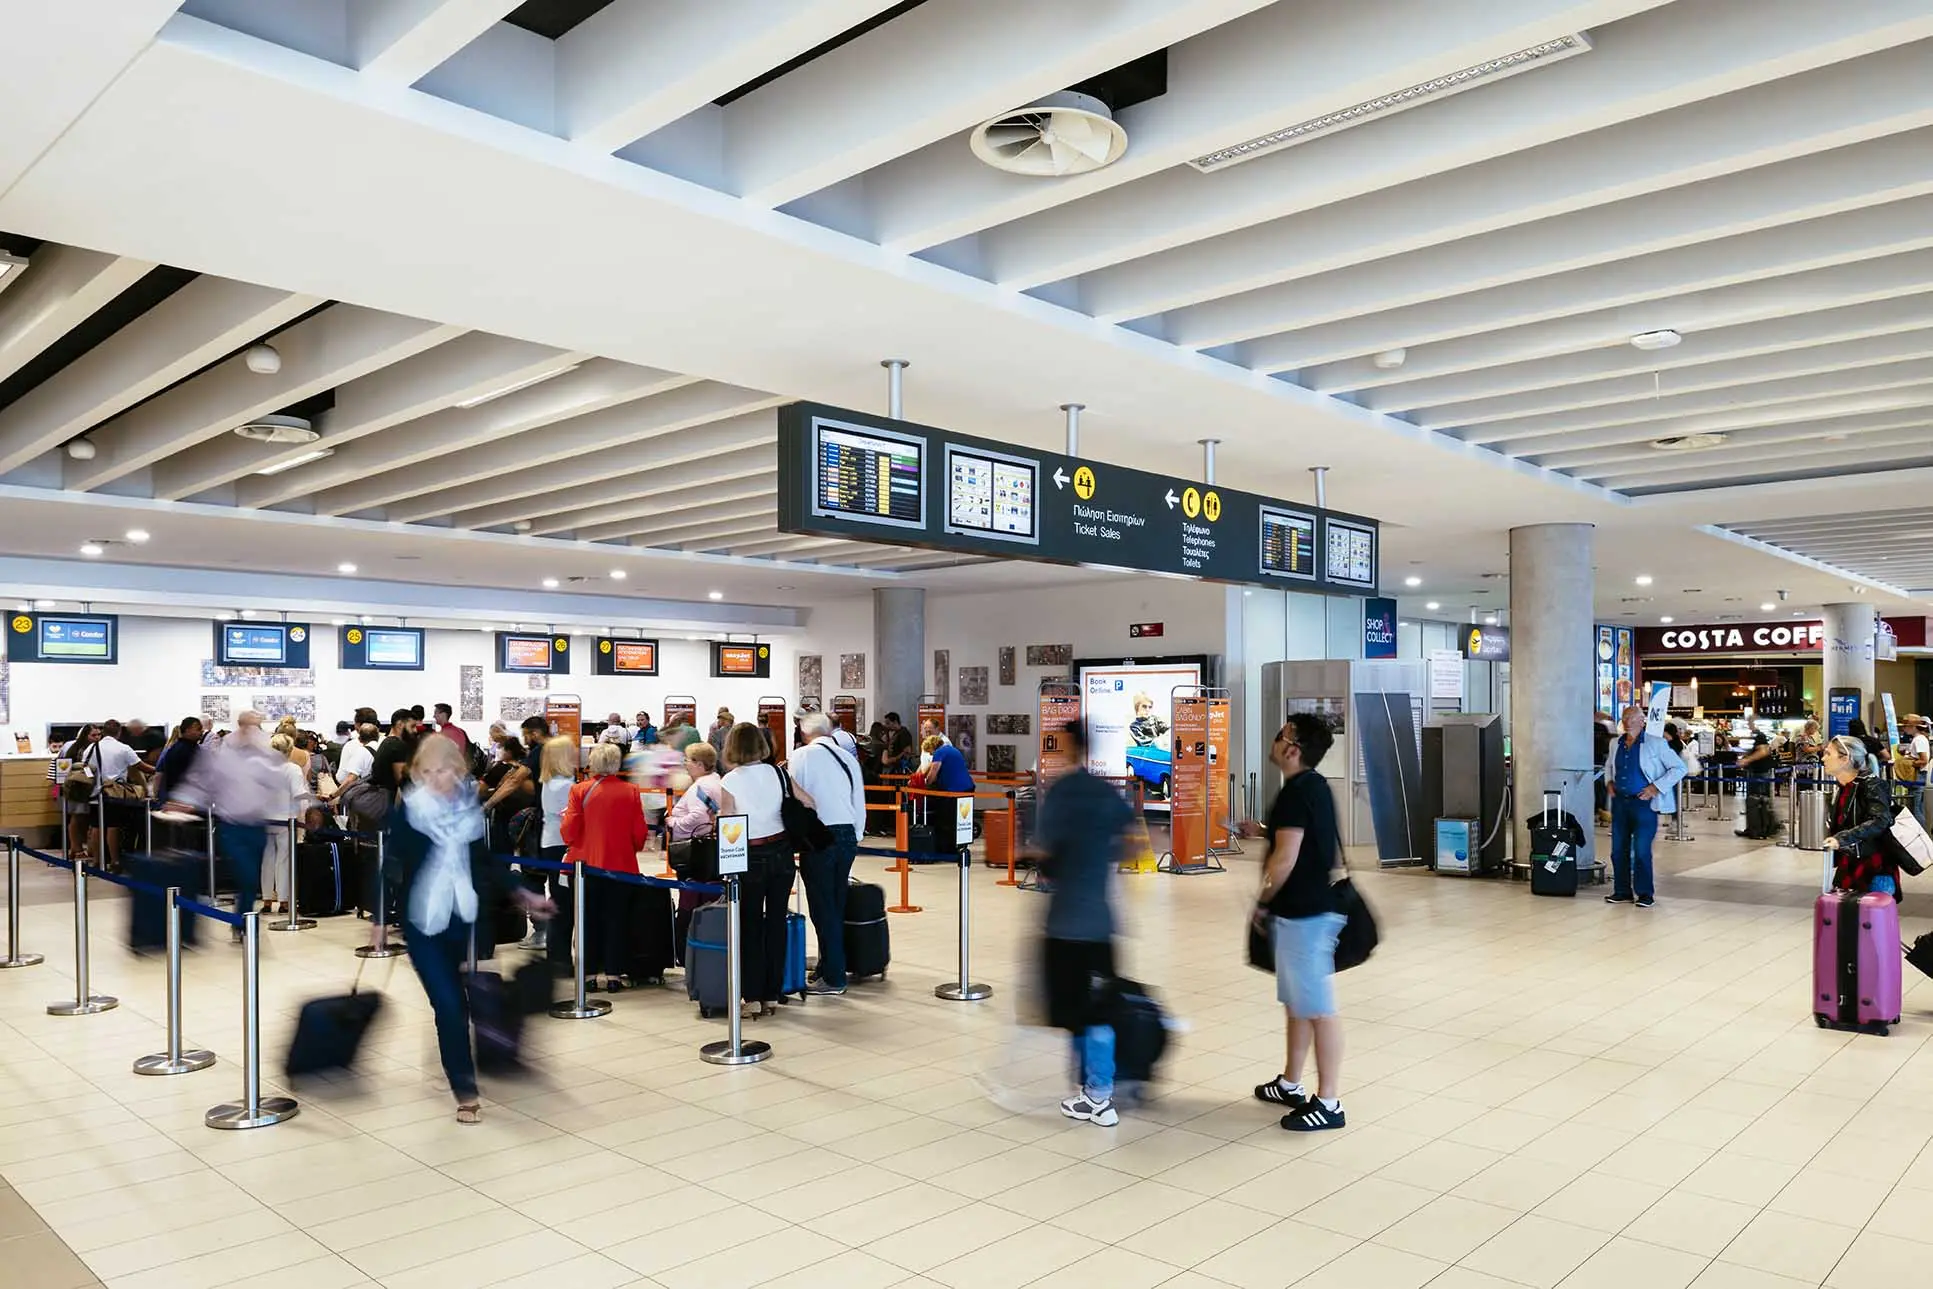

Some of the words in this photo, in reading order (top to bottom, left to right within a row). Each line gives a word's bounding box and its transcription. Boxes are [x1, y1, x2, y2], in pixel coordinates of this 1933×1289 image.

[1073, 504, 1105, 523] Πώληση
[1106, 510, 1145, 527] Εισιτηρίων
[1073, 521, 1098, 537] Ticket
[1100, 526, 1121, 540] Sales
[1182, 533, 1216, 548] Telephones
[1182, 557, 1202, 568] Toilets
[15, 619, 31, 630] 23
[1366, 618, 1384, 630] SHOP
[348, 631, 361, 641] 25
[1366, 631, 1393, 644] COLLECT
[1661, 629, 1744, 650] COSTA
[1753, 626, 1823, 646] COFF
[556, 640, 566, 650] 26
[601, 642, 610, 651] 27
[1090, 677, 1107, 685] Book
[1042, 705, 1057, 714] BAG
